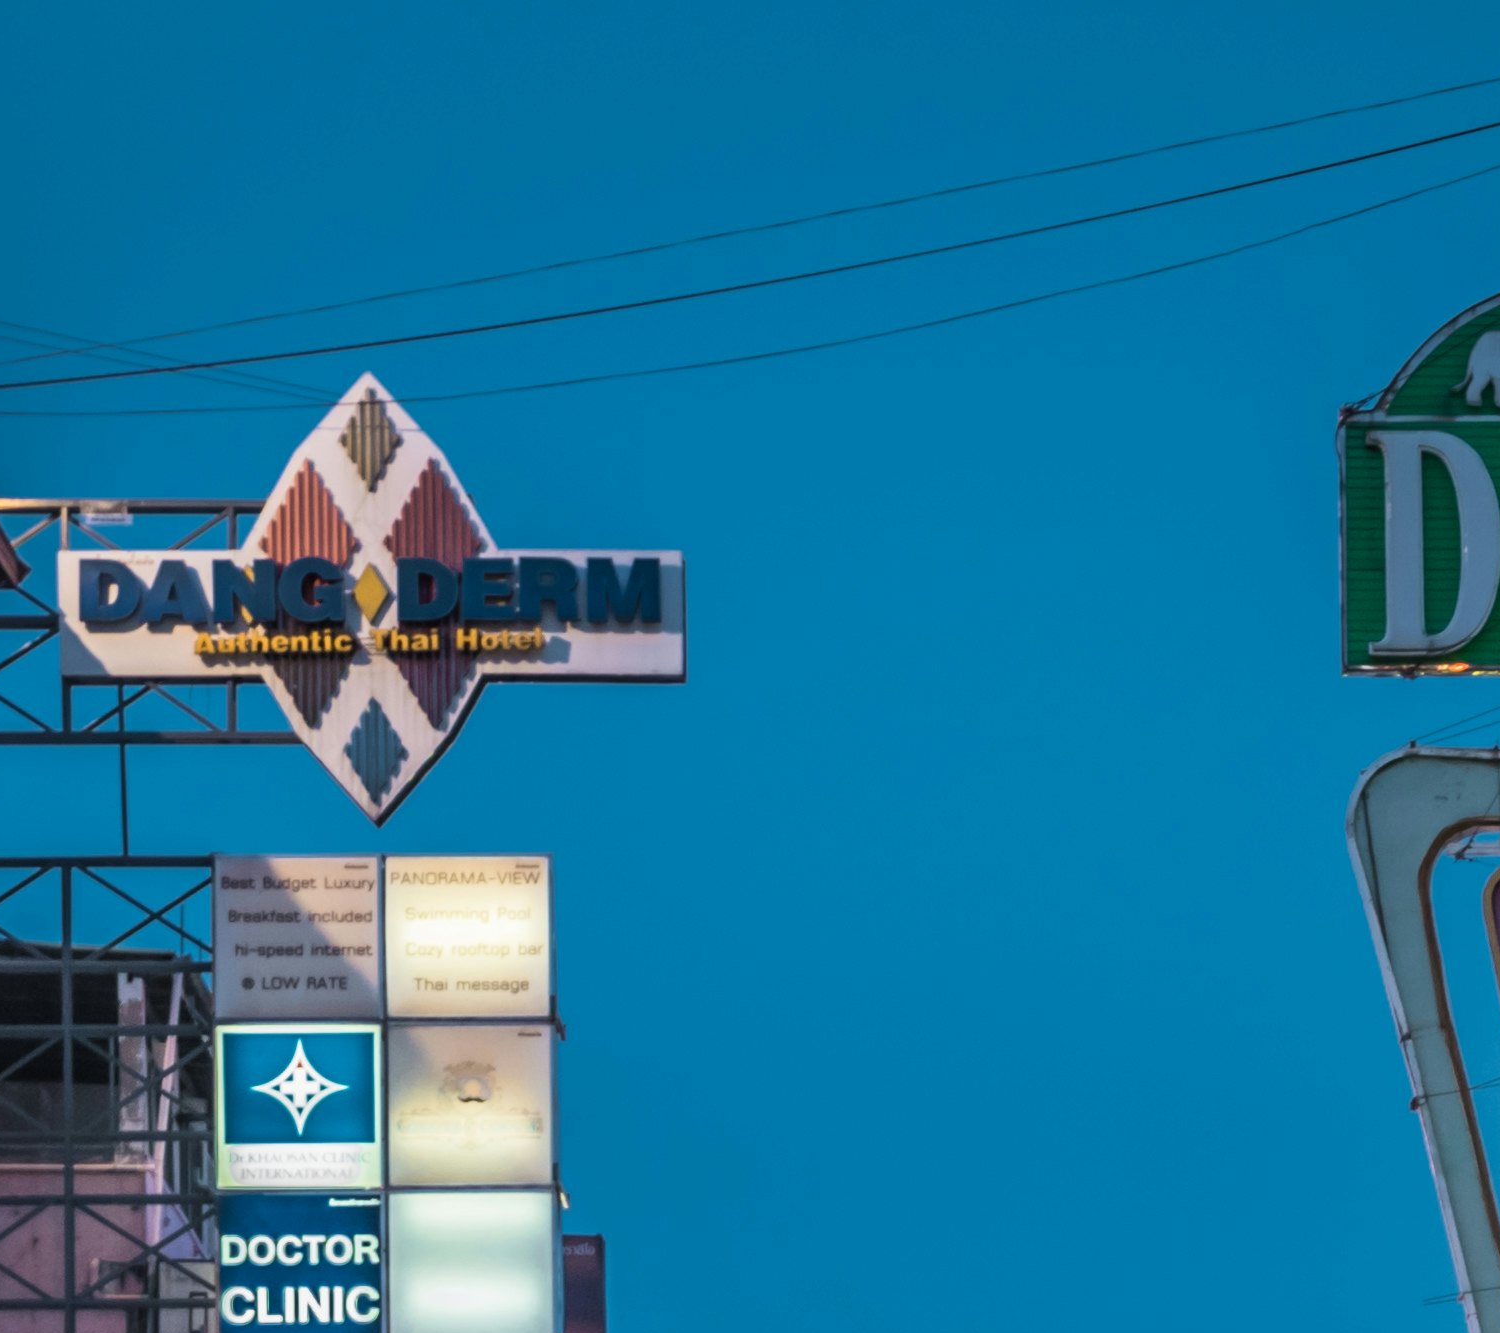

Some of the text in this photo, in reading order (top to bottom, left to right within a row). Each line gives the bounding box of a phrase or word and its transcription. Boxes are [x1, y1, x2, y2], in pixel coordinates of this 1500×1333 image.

[77, 555, 663, 626] DANG DERM
[193, 626, 546, 655] Authentic Thai Hotel
[220, 875, 376, 893] Best Budget Luxury
[389, 871, 542, 886] PANORAMA-VIEW
[228, 908, 373, 924] Breakfast included
[234, 942, 374, 959] hi-speed internet
[261, 976, 349, 991] LOW RATE
[414, 977, 531, 994] Thai message
[220, 1234, 381, 1267] DOCTOR
[220, 1285, 381, 1325] CLINIC
